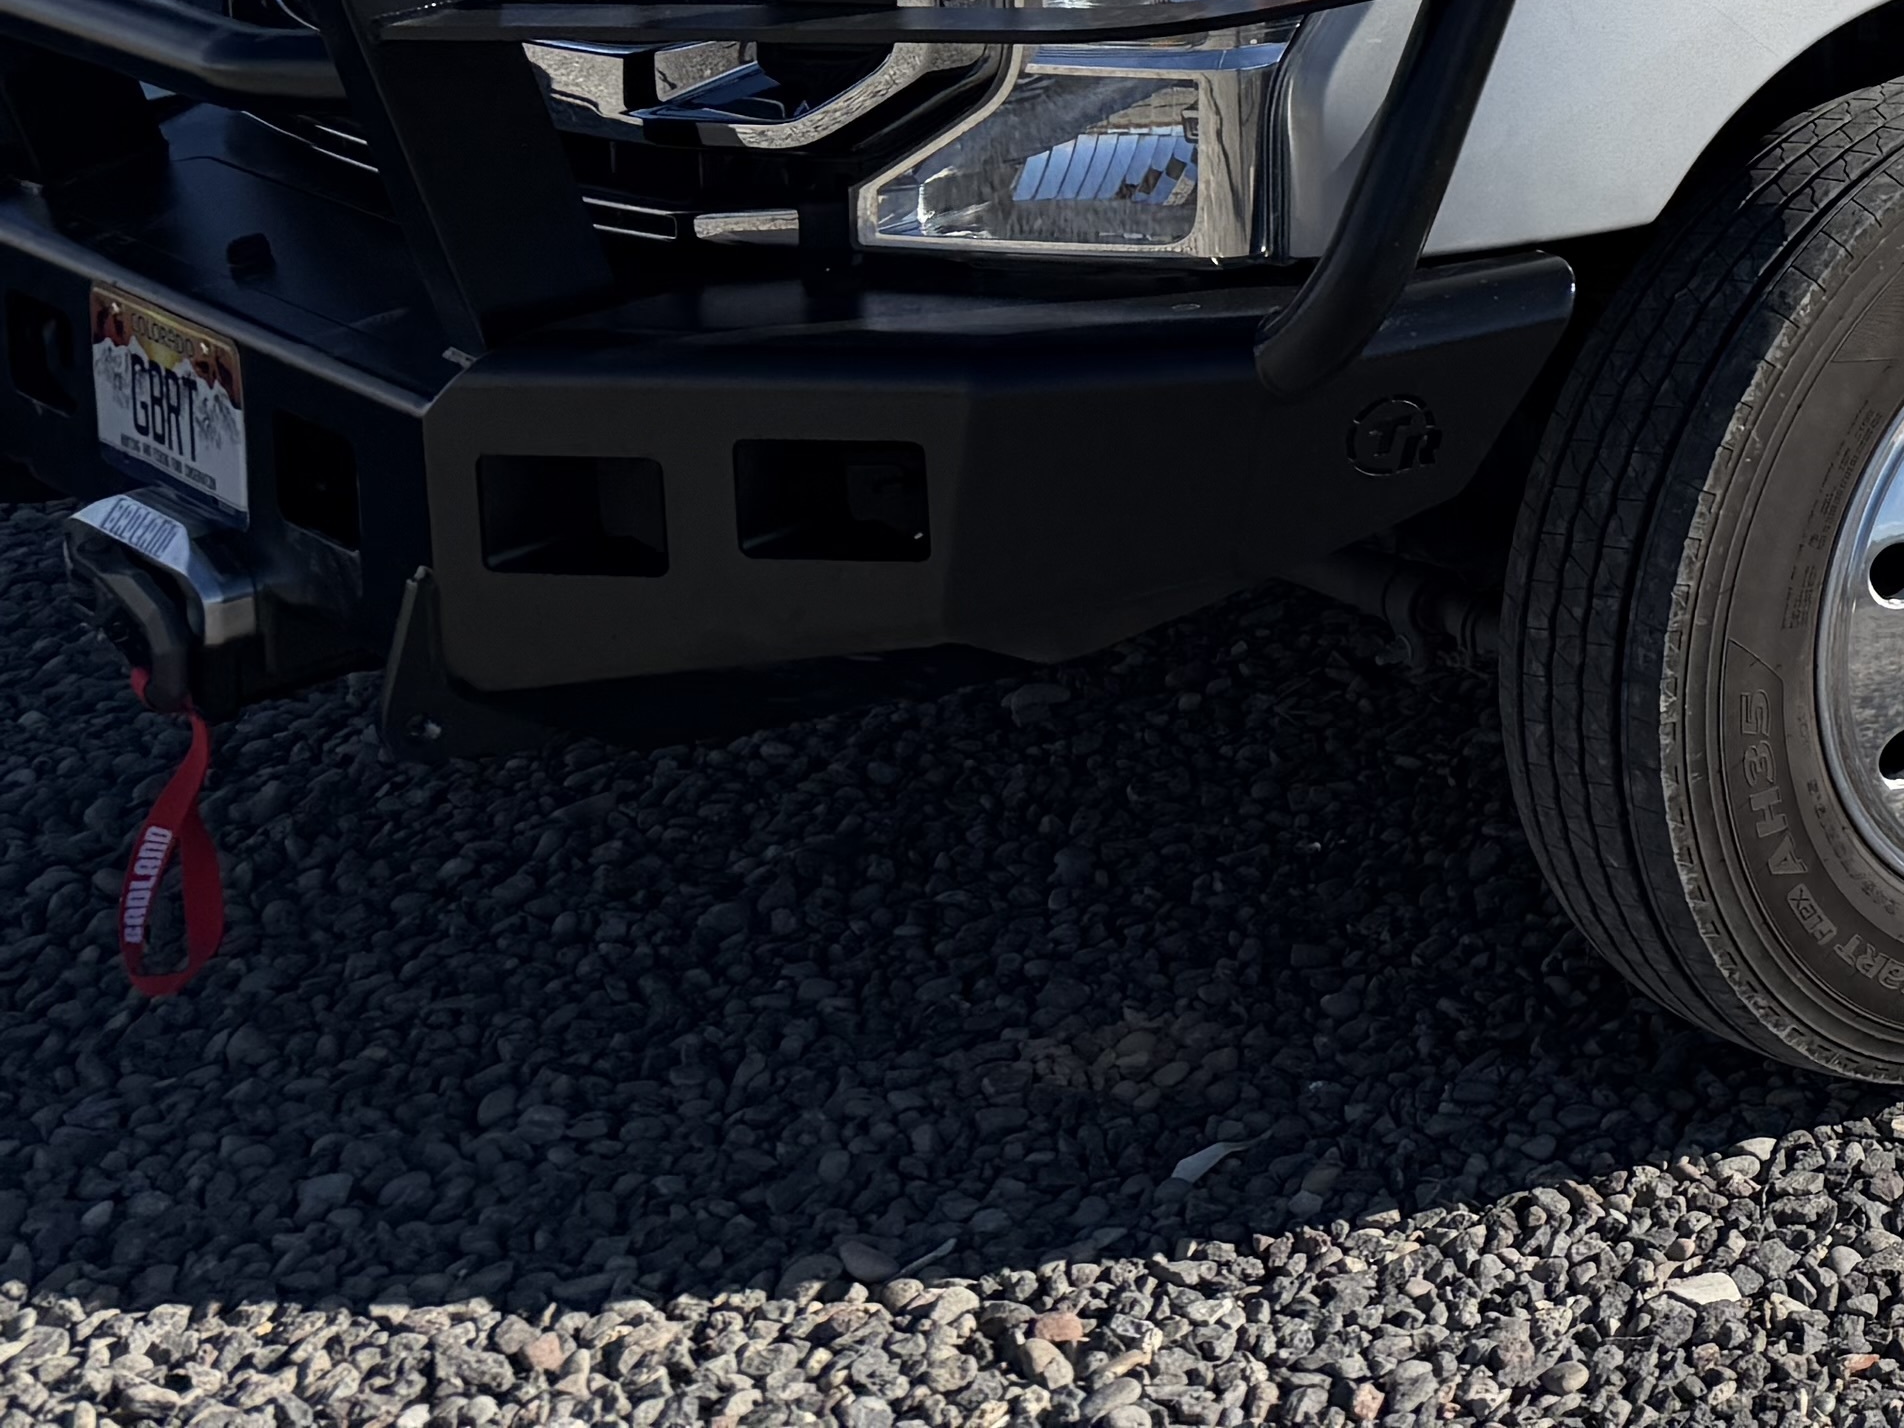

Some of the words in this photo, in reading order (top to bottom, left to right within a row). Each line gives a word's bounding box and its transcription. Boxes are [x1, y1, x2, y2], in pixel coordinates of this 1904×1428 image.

[132, 312, 196, 359] COLORADO
[130, 352, 198, 463] GBRT
[1738, 687, 1809, 878] AH35
